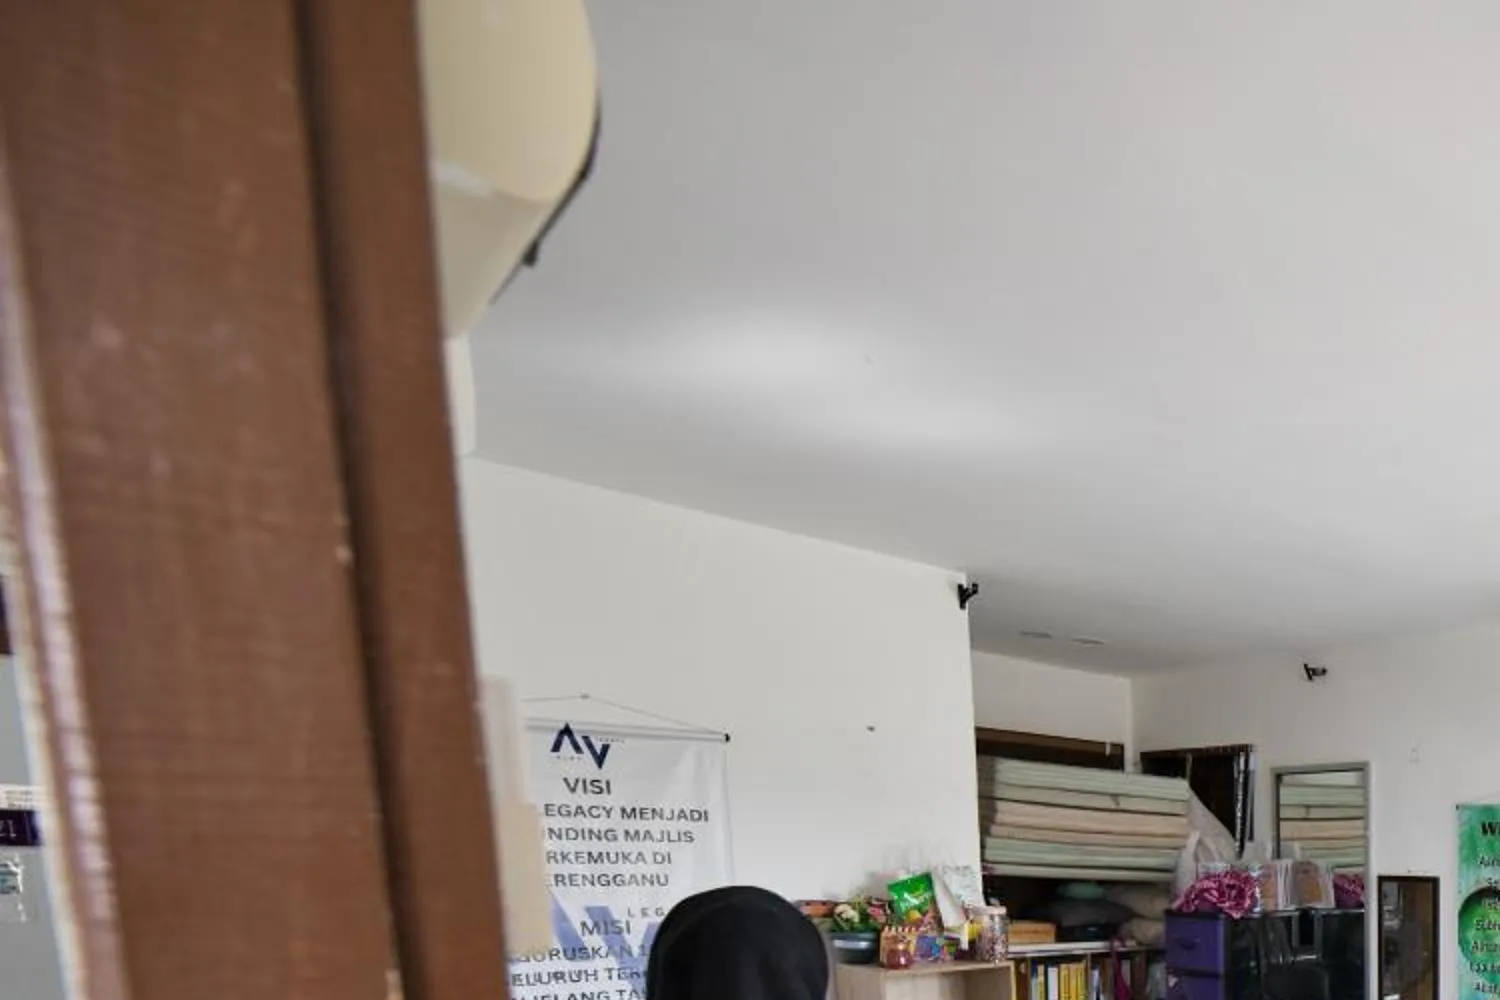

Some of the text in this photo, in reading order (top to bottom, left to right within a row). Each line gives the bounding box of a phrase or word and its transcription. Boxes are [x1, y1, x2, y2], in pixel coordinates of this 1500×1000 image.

[562, 776, 613, 796] VISI
[543, 802, 709, 823] EGACY MENJADI
[543, 827, 696, 844] NDING MAJLIS
[546, 850, 672, 866] RKEMUKA DI
[546, 873, 669, 888] RENGGANU
[580, 920, 631, 937] MISI
